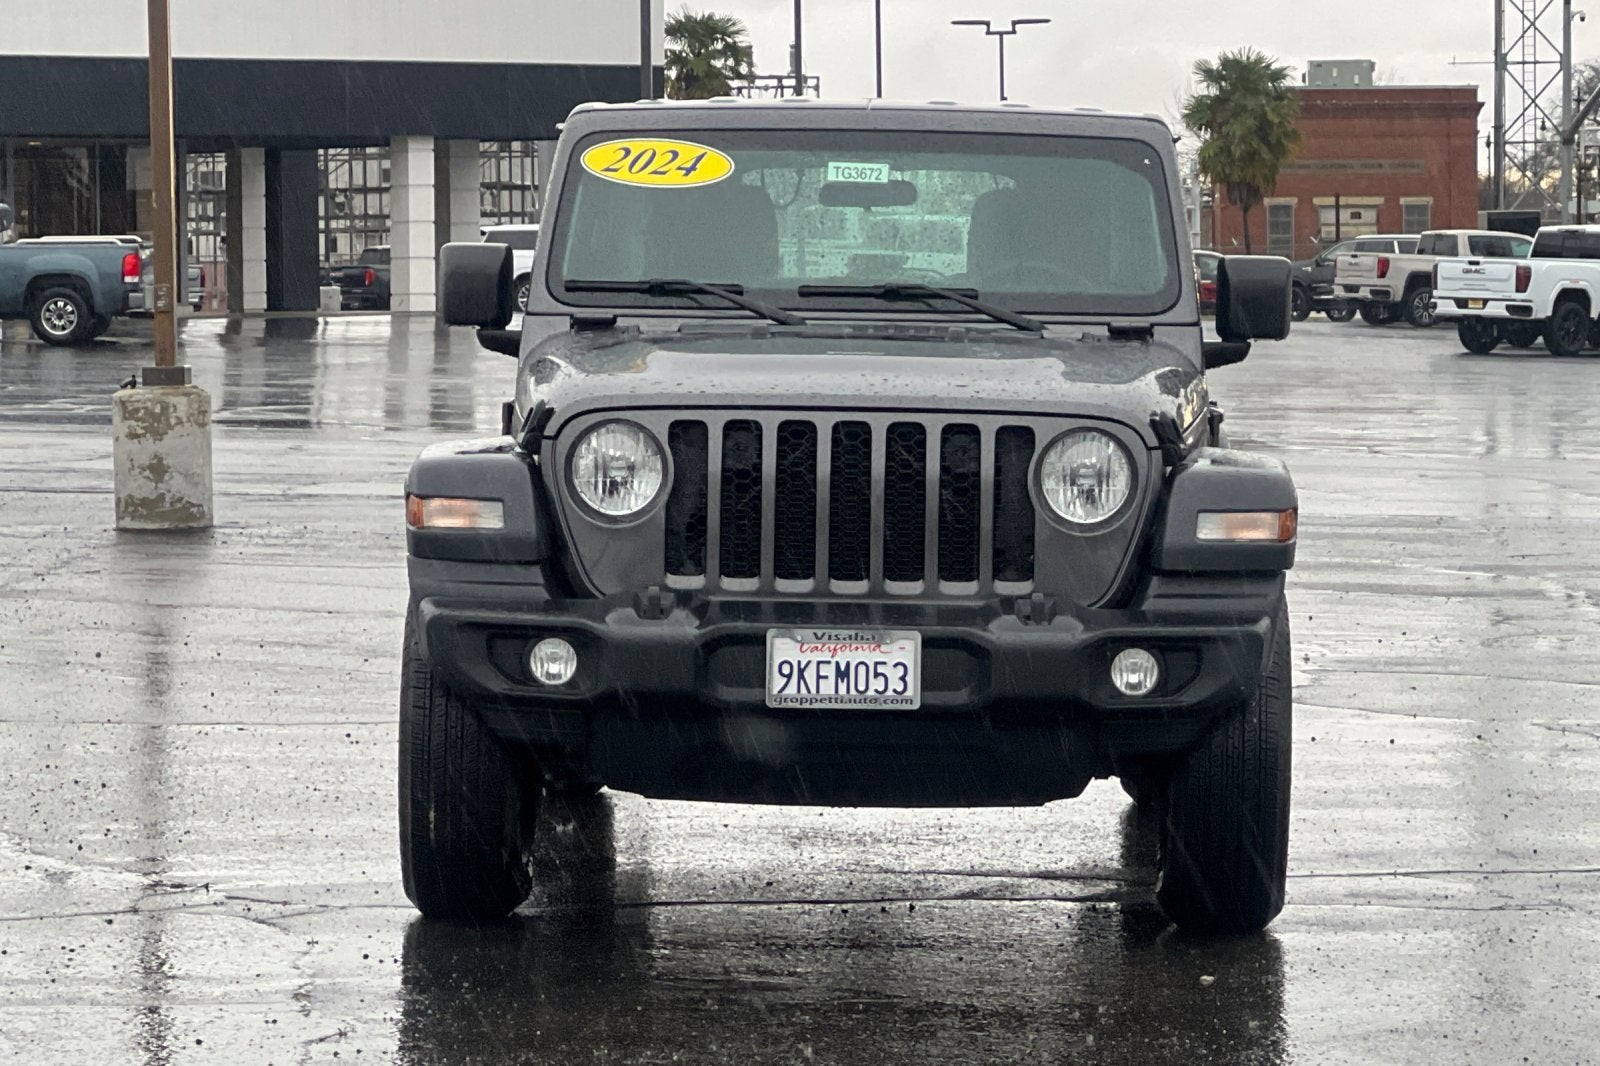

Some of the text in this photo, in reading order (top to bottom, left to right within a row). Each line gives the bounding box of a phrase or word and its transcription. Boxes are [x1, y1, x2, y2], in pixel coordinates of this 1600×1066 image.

[600, 146, 708, 177] 2024
[833, 166, 883, 181] TG3672
[812, 631, 877, 642] Visalia
[800, 641, 893, 659] California
[777, 659, 909, 696] 9KFM053
